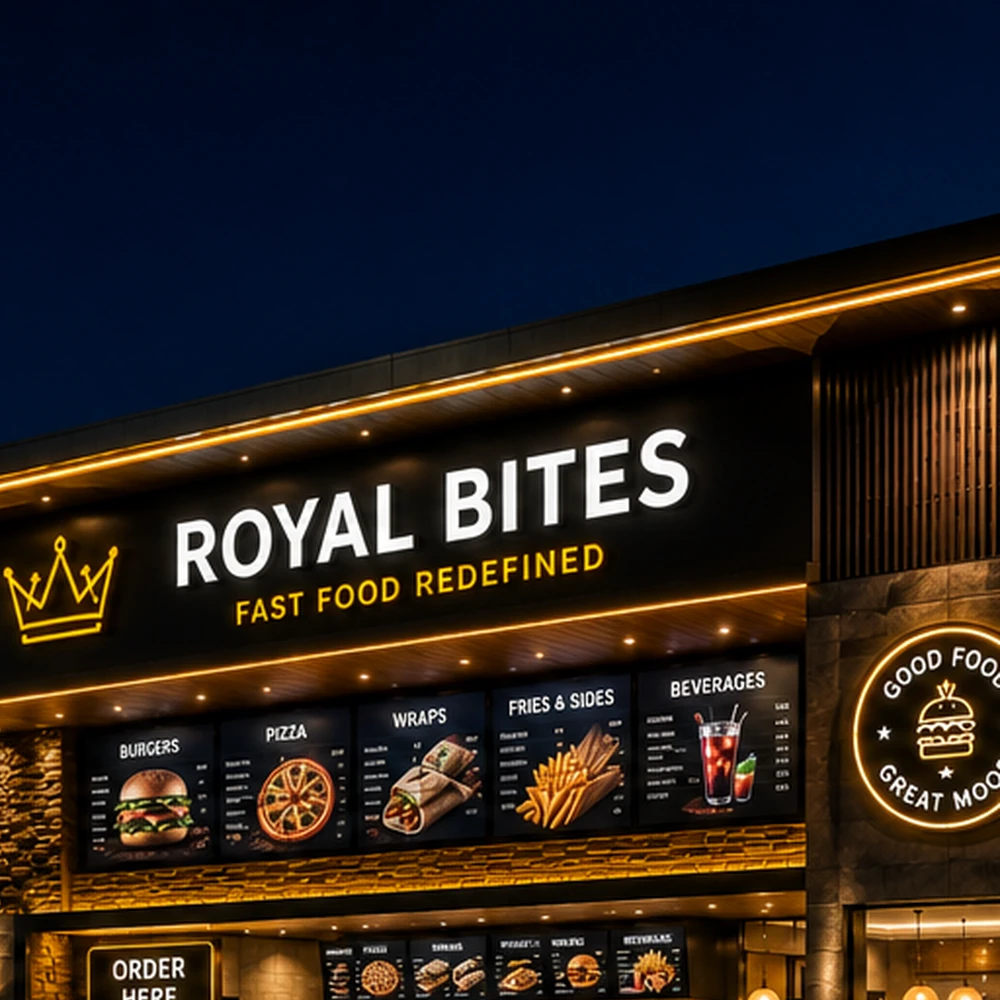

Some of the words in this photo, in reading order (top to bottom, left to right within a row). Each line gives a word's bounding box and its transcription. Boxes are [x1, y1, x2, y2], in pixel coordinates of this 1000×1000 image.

[177, 484, 414, 588] ROYAL
[446, 429, 689, 542] BITES
[237, 591, 304, 626] FAST
[317, 576, 400, 613] FOOD
[415, 542, 604, 596] REDEFINED
[670, 671, 766, 698] BEVERAGES
[884, 649, 943, 699] GOOD
[508, 695, 551, 717] FRIES
[555, 694, 567, 711] &
[569, 688, 615, 709] SIDES
[392, 707, 447, 728] WRAPS
[265, 723, 308, 742] PIZZA
[119, 738, 180, 759] BURGERS
[880, 765, 944, 812] GREAT
[952, 759, 1000, 811] MOO
[112, 956, 186, 981] ORDER
